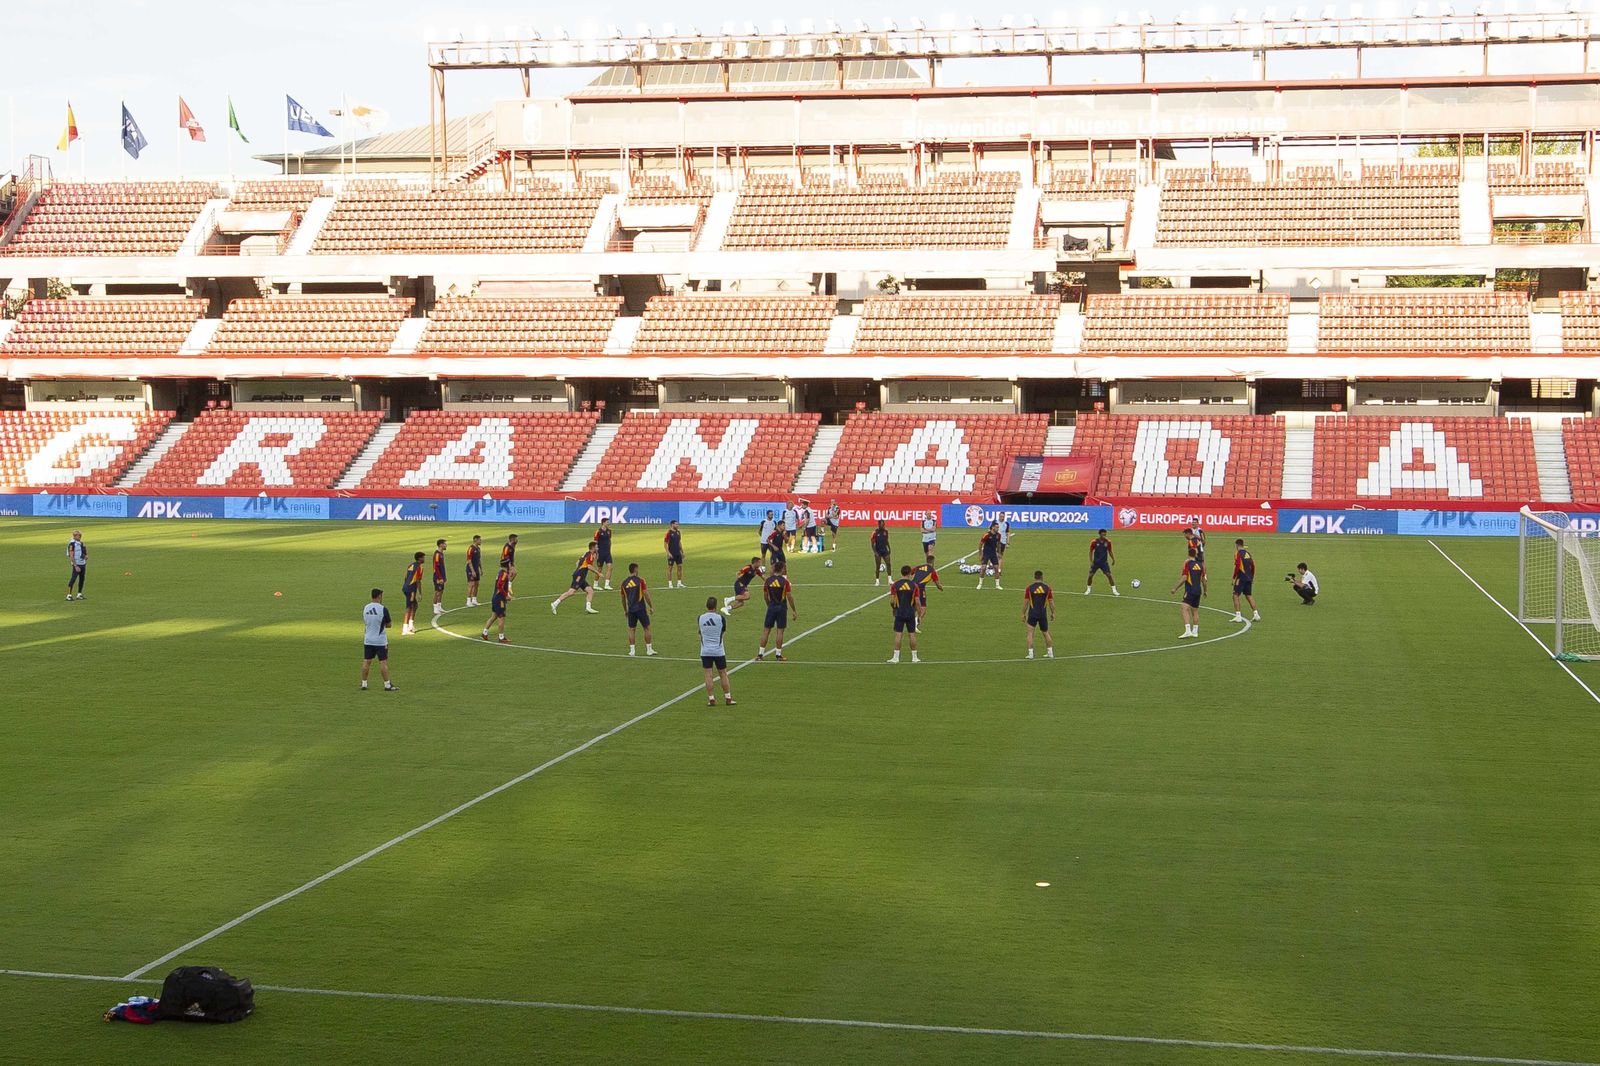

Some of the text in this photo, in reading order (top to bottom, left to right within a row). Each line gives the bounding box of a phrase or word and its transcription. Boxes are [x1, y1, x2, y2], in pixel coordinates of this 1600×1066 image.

[1039, 118, 1058, 135] al
[1064, 117, 1131, 134] Nuevo
[1138, 115, 1172, 133] Los
[47, 494, 122, 513] APK renting
[137, 501, 182, 518] APK
[243, 496, 321, 514] APK renting
[356, 503, 403, 521] APK
[463, 499, 546, 516] APK renting
[695, 501, 780, 520] APK rentig
[580, 506, 629, 524] APK
[812, 509, 870, 521] EUPEAN
[1139, 513, 1274, 526] EUROPEAN QUALIFIERS
[1290, 514, 1345, 534] APK
[1421, 511, 1517, 530] APK renting
